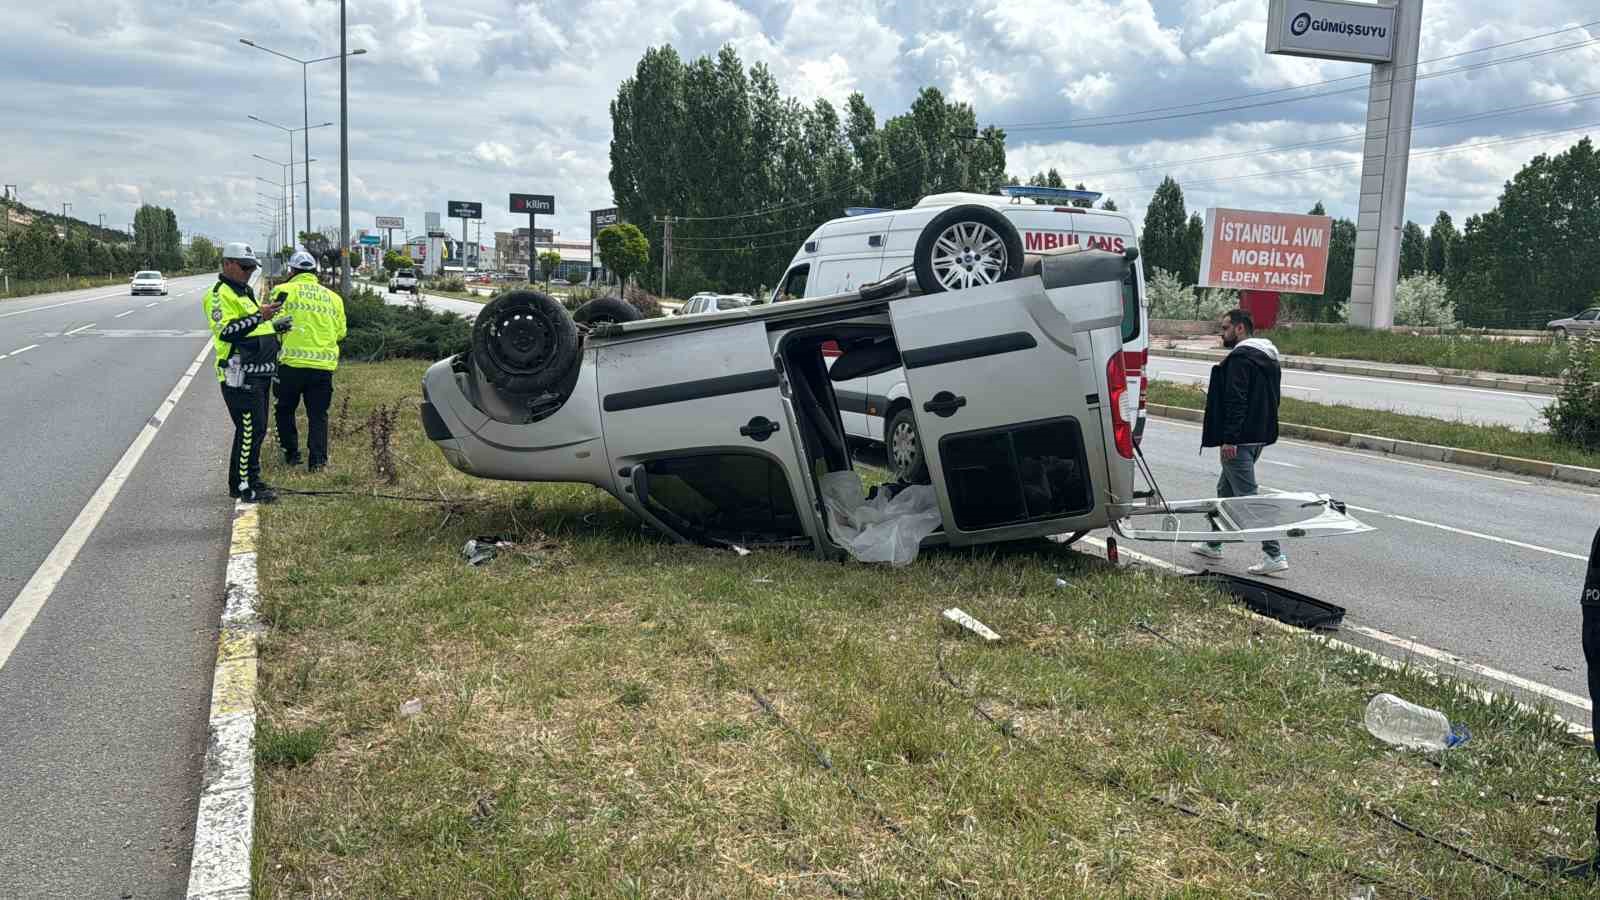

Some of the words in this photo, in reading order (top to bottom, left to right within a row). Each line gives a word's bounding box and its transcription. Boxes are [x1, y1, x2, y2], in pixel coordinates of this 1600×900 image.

[1311, 19, 1386, 38] GÜMÜŞSUYU
[526, 199, 550, 209] kilim
[1220, 217, 1288, 245] İSTANBUL
[1292, 226, 1322, 248] AVM
[1025, 231, 1126, 255] MBUANS
[1231, 248, 1305, 269] MOBİLYA
[1221, 270, 1260, 283] ELDEN
[1263, 270, 1313, 287] TAKSİT
